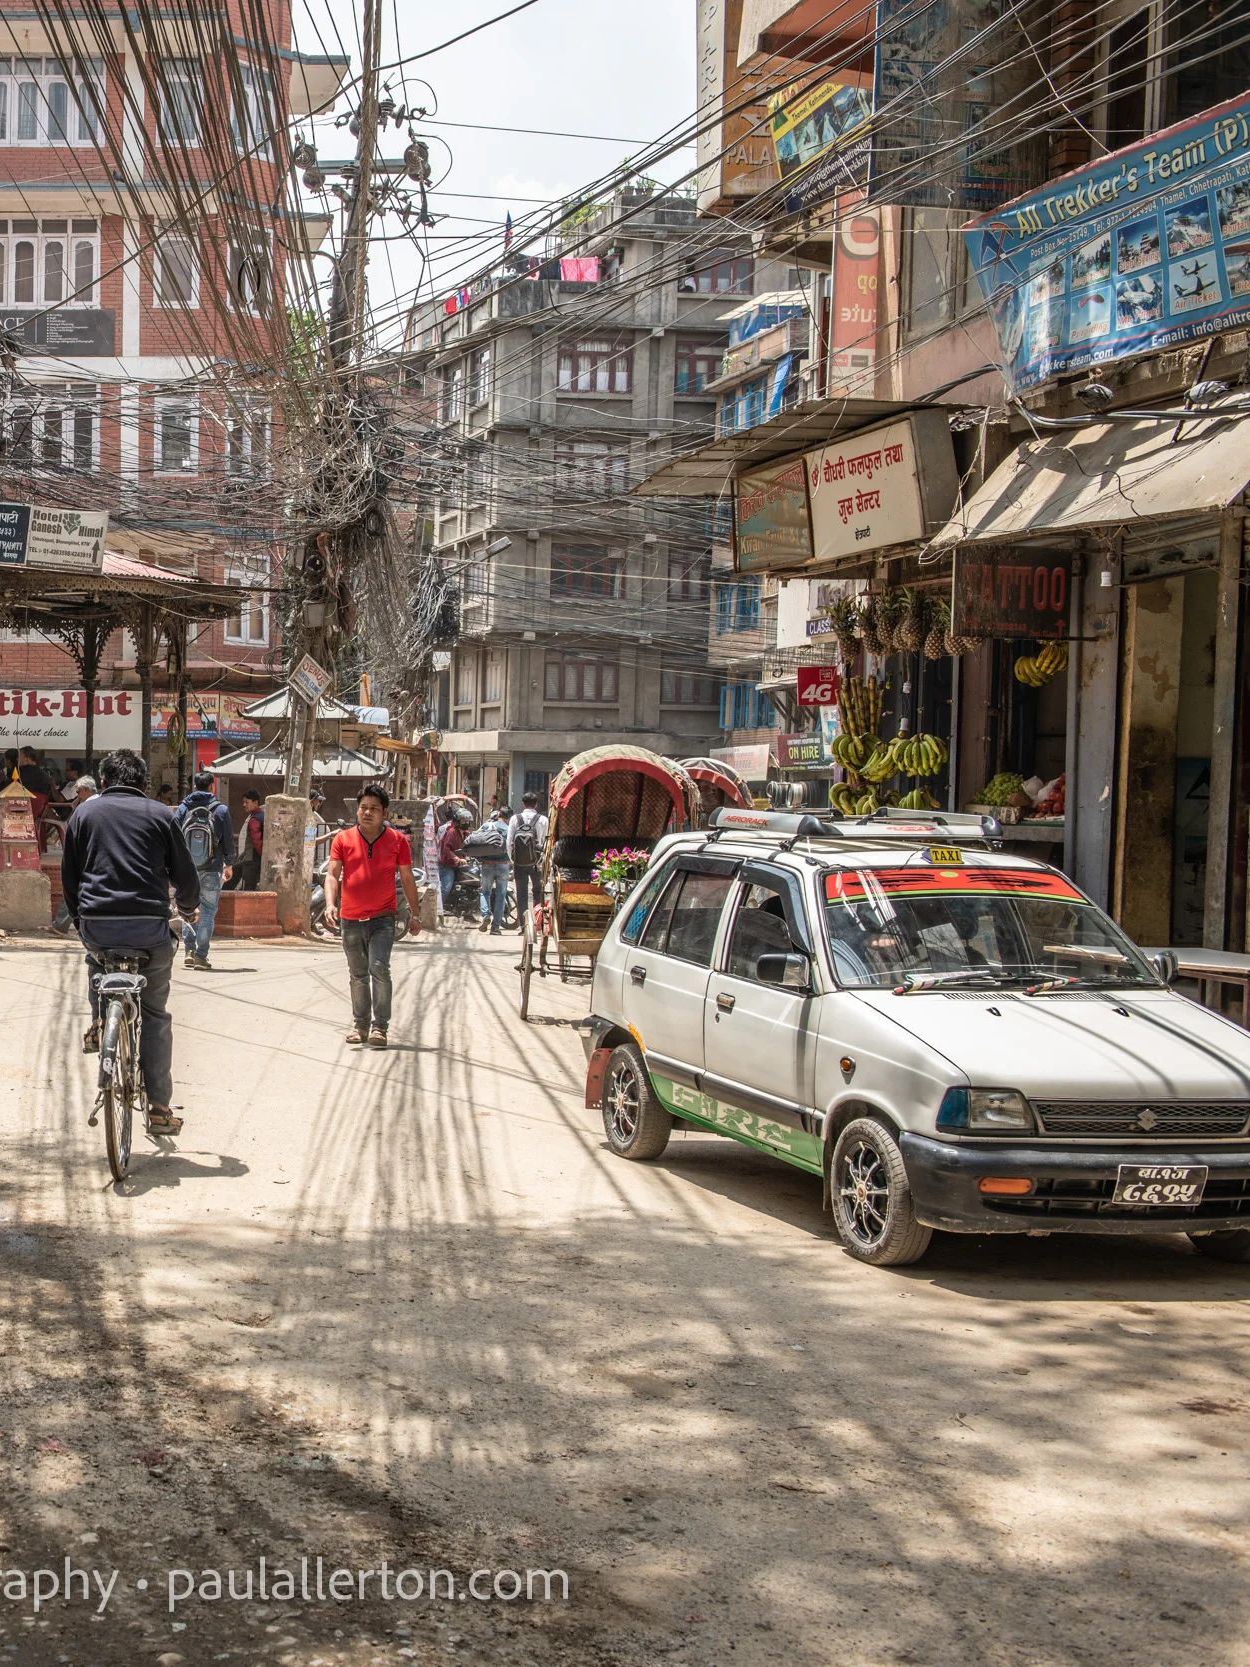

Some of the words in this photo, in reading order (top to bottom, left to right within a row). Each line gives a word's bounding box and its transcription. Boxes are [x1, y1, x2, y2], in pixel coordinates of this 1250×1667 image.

[726, 144, 773, 166] PALA
[1014, 202, 1043, 241] All
[1044, 162, 1139, 226] Trekker's
[1143, 136, 1206, 185] Team
[1214, 111, 1250, 156] (P)
[1030, 246, 1043, 259] Post
[1043, 241, 1056, 254] Box
[1093, 220, 1105, 235] Tel:
[1160, 189, 1188, 209] Thamel,
[1189, 172, 1235, 198] Chhetrapati,
[1235, 162, 1250, 181] Kat
[1192, 233, 1212, 246] Tour
[1234, 281, 1250, 293] Ult
[1173, 299, 1189, 311] Air
[1190, 290, 1217, 307] Ticket
[1151, 329, 1189, 347] E-mail:
[1191, 311, 1250, 337] info@alltre
[823, 455, 847, 484] चौधरी
[847, 450, 882, 480] फलफुल
[884, 443, 904, 468] तथा
[33, 509, 62, 523] Hotel
[838, 497, 854, 525] जुस
[856, 488, 881, 513] सेन्टर
[31, 520, 62, 535] Ganesh
[78, 525, 104, 538] Himal
[740, 532, 764, 556] Kiran
[961, 563, 1065, 612] TATTOO
[801, 683, 832, 703] 4G
[12, 727, 41, 738] widest
[43, 727, 69, 738] choice
[788, 747, 799, 760] ON
[801, 745, 820, 760] HIRE
[723, 814, 771, 826] AERORACK
[931, 850, 962, 863] TAXI
